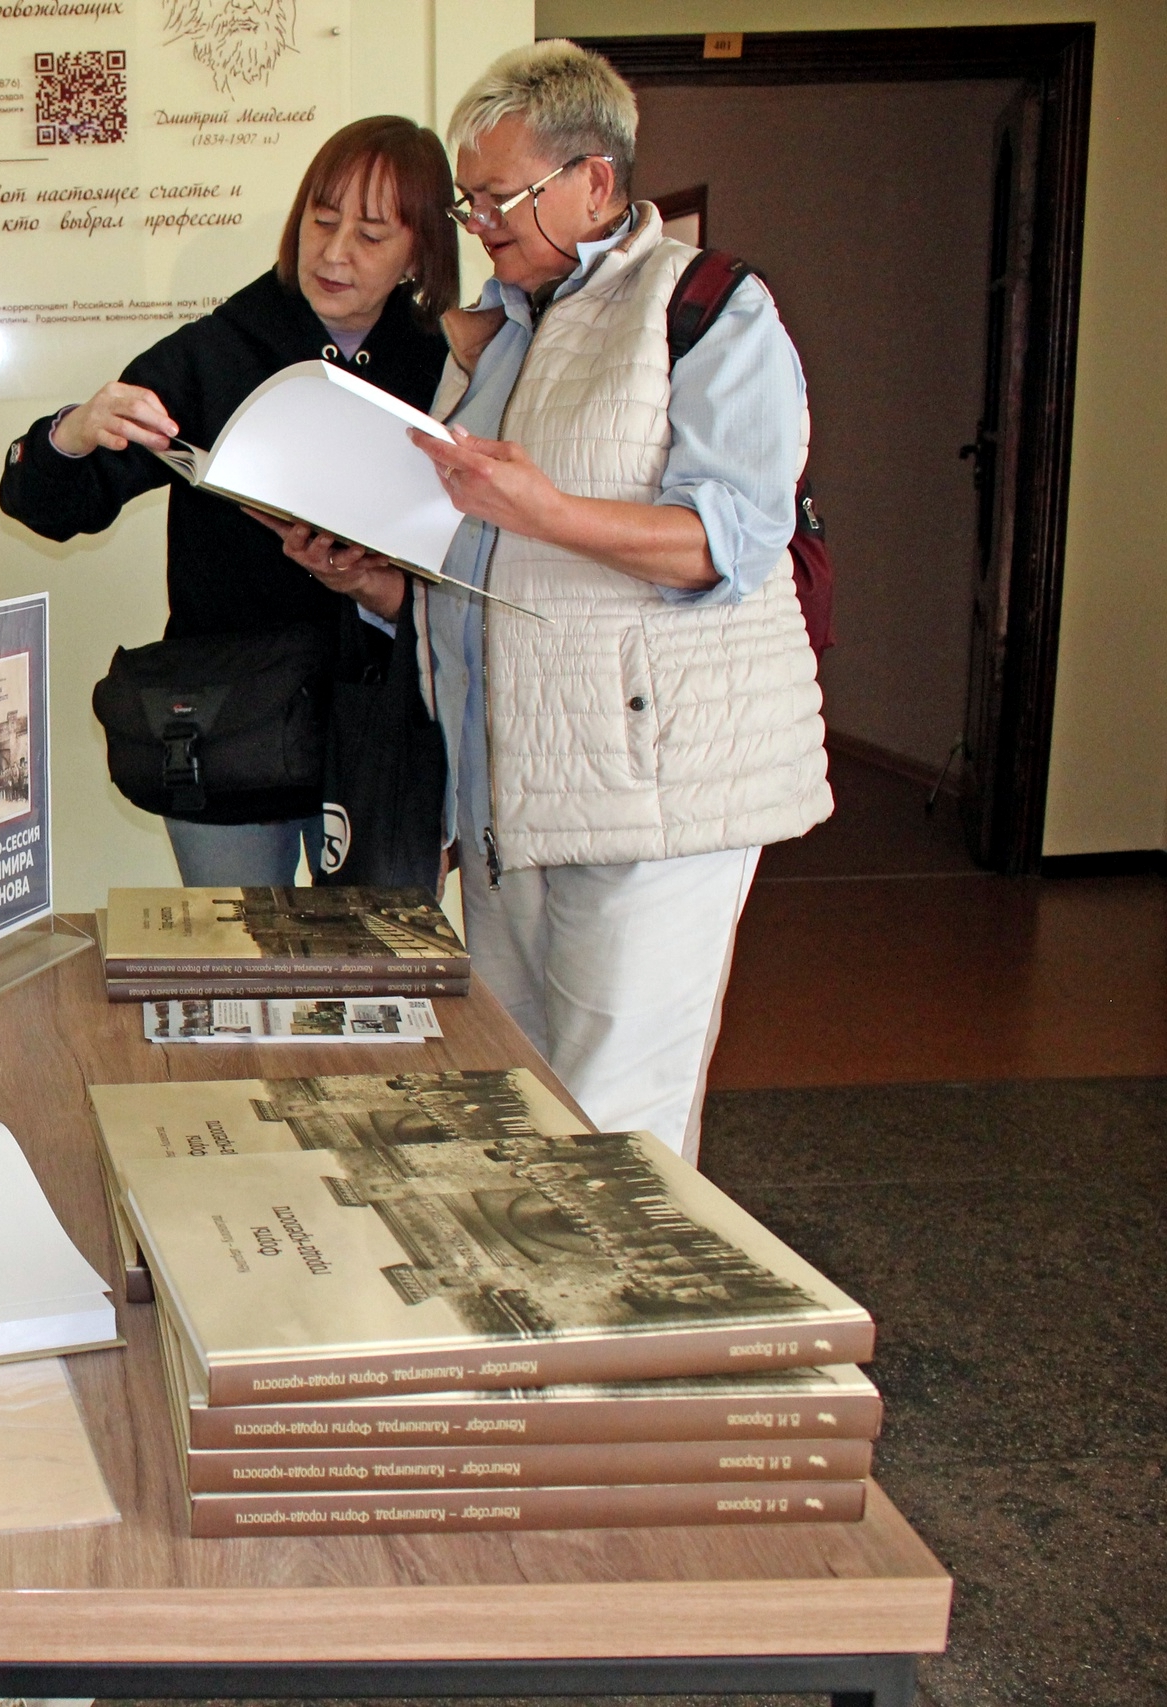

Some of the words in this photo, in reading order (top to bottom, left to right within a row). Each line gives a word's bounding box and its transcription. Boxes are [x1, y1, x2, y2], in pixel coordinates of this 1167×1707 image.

[154, 109, 228, 131] Дмитрий
[236, 105, 316, 123] Менделеев
[36, 185, 140, 208] настоящее
[149, 184, 220, 199] счастье
[230, 184, 242, 198] и
[2, 216, 40, 232] кто
[60, 206, 125, 238] выбрал
[144, 207, 243, 236] профессию
[73, 299, 124, 310] Российской
[128, 299, 172, 308] Академии
[177, 299, 198, 309] наук
[36, 314, 101, 324] Родоначальник
[185, 1134, 209, 1157] Форты
[250, 1225, 283, 1257] Форты
[272, 1205, 332, 1275] города-крепости
[729, 1342, 773, 1357] Воронов
[479, 1360, 538, 1376] Кёнигсберг
[253, 1372, 345, 1391] города-крепости
[349, 1369, 389, 1386] Форты
[465, 1418, 526, 1433] Кёнигсберг
[727, 1411, 774, 1427] Воронов
[234, 1421, 328, 1437] города-крепости
[332, 1421, 372, 1436] Форты
[460, 1461, 521, 1477] Кёнигсберг
[719, 1454, 765, 1470] Воронов
[233, 1464, 326, 1480] города-крепости
[329, 1463, 369, 1479] Форты
[460, 1505, 521, 1521] Кёнигсберг
[717, 1497, 762, 1513] Воронов
[236, 1509, 327, 1525] города-крепости
[331, 1508, 370, 1524] Форты
